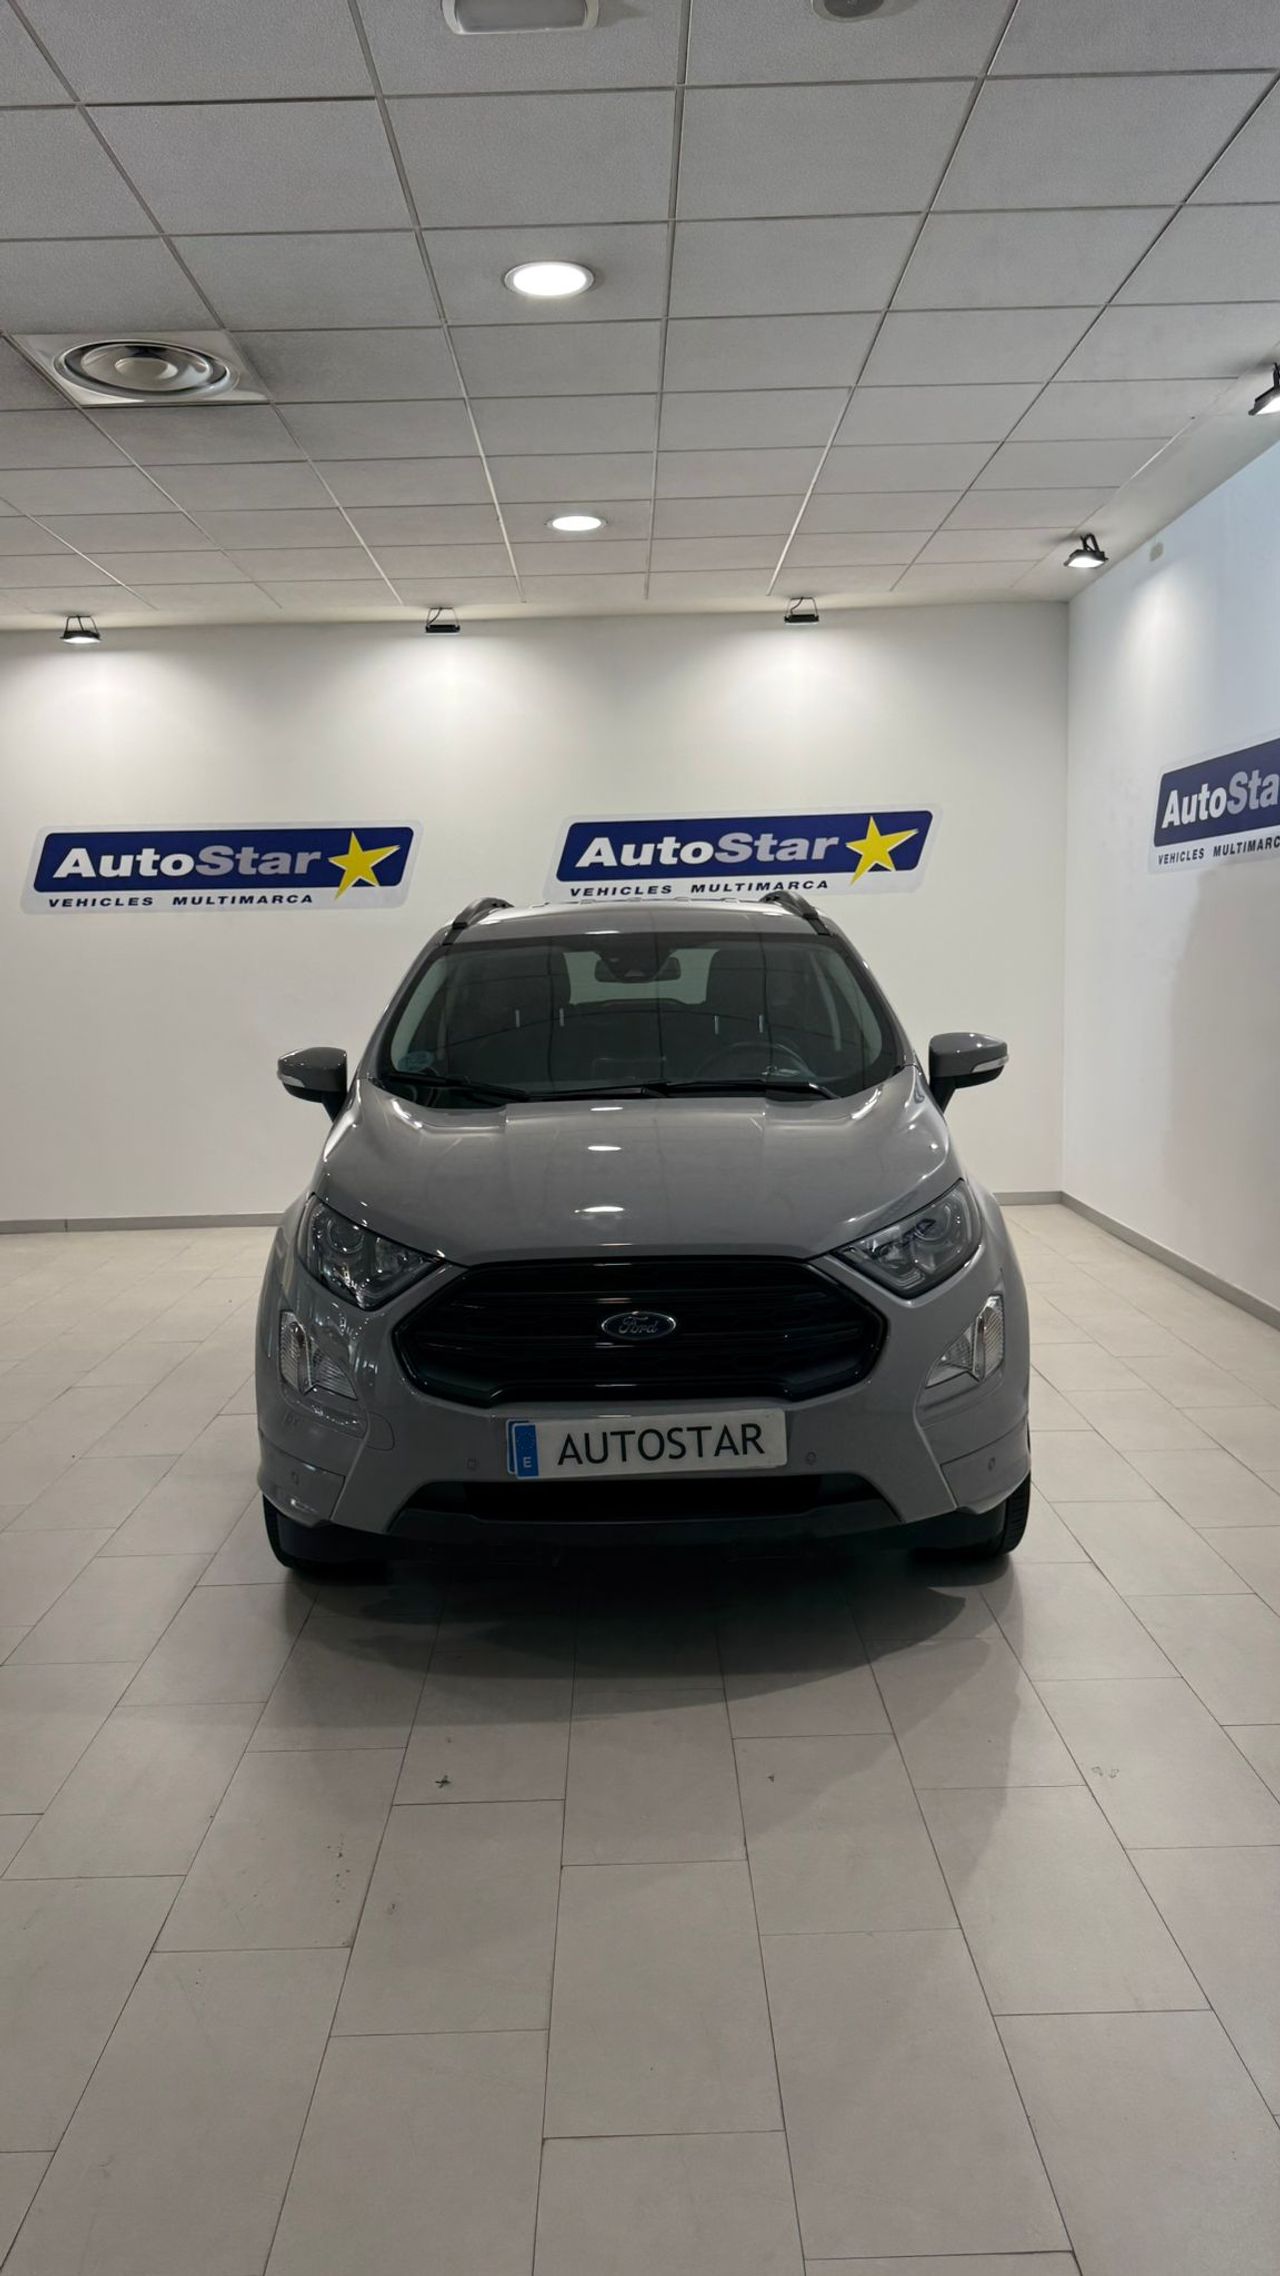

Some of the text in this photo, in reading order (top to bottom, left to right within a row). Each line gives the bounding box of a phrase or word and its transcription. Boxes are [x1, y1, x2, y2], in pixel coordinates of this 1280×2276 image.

[1161, 769, 1280, 829] AutoSta
[52, 845, 322, 879] AutoStar
[574, 832, 840, 868] AutoStar
[1158, 835, 1280, 865] VEHICLES MULTIMARC
[48, 894, 314, 908] VEHICLES MULTIMARCA
[570, 880, 829, 897] VEHICLES MULTIMARCA
[618, 1316, 658, 1334] Ford
[523, 1422, 766, 1468] E AUTOSTAR
